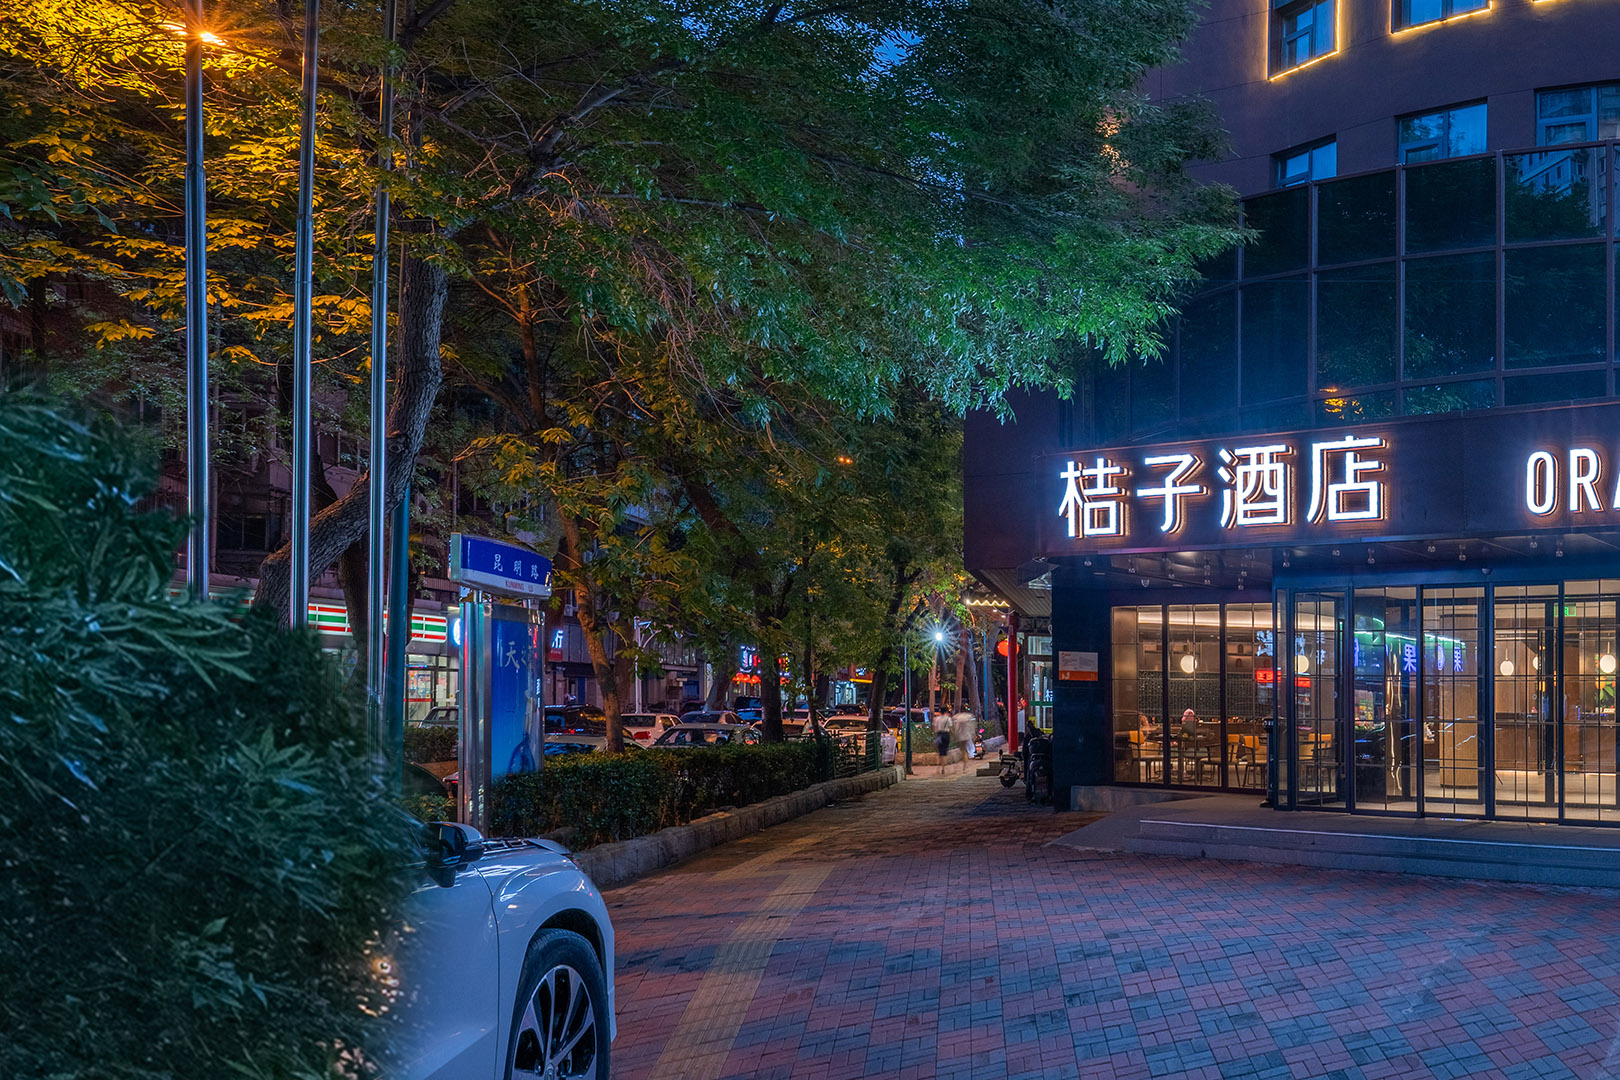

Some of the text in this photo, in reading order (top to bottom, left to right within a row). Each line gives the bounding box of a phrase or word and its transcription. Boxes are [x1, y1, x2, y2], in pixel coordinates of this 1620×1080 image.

[1058, 435, 1388, 539] 桔子酒店
[493, 553, 540, 580] 昆明路
